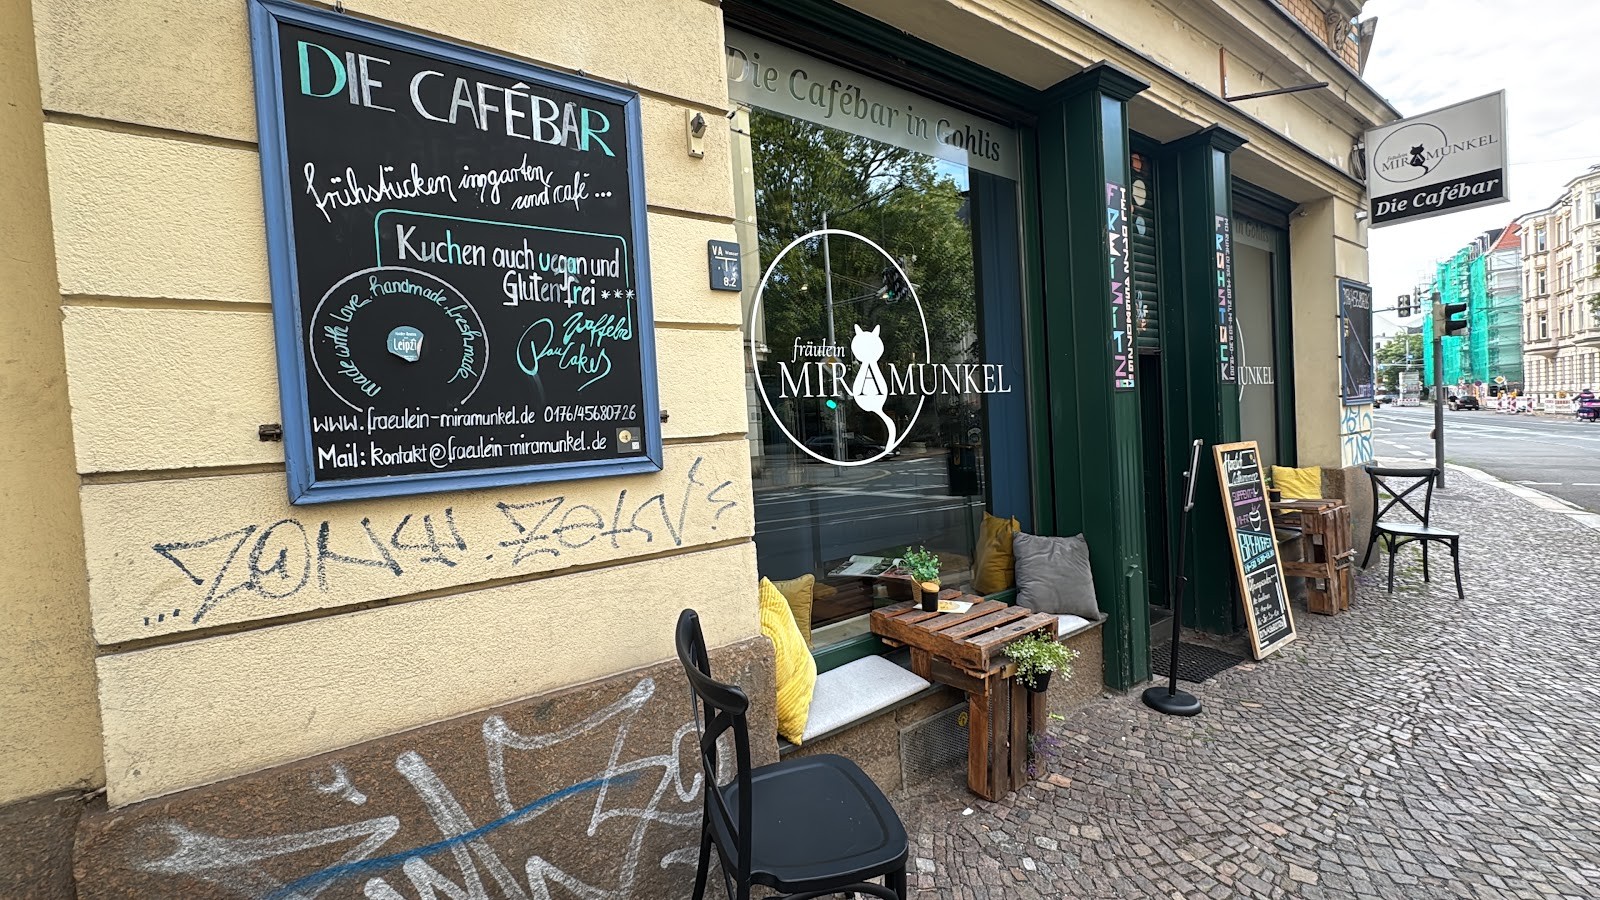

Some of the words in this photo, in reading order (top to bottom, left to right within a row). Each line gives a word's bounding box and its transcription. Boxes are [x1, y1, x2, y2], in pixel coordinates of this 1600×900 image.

[297, 40, 396, 113] DIE
[726, 46, 778, 92] Die
[789, 70, 899, 128] Cafébar
[906, 105, 928, 140] in
[935, 118, 1000, 162] Gohlis
[1382, 135, 1498, 172] MIRAMUNKEL
[304, 162, 457, 223] frühstücken
[511, 171, 553, 210] und
[1375, 199, 1408, 217] Die
[1412, 179, 1499, 207] Cafébar
[396, 224, 486, 266] Kuchen
[492, 238, 535, 271] auch
[590, 248, 619, 278] und
[712, 245, 724, 256] VA
[324, 325, 351, 358] with
[792, 337, 845, 362] fräulein
[338, 360, 382, 397] made
[777, 360, 1012, 399] MIRAMUNKEL
[1238, 366, 1274, 385] UNKEL
[313, 405, 535, 435] www.fraeulein-miramunkel.de
[544, 404, 637, 422] 0176/45680726
[318, 443, 366, 469] Mail:
